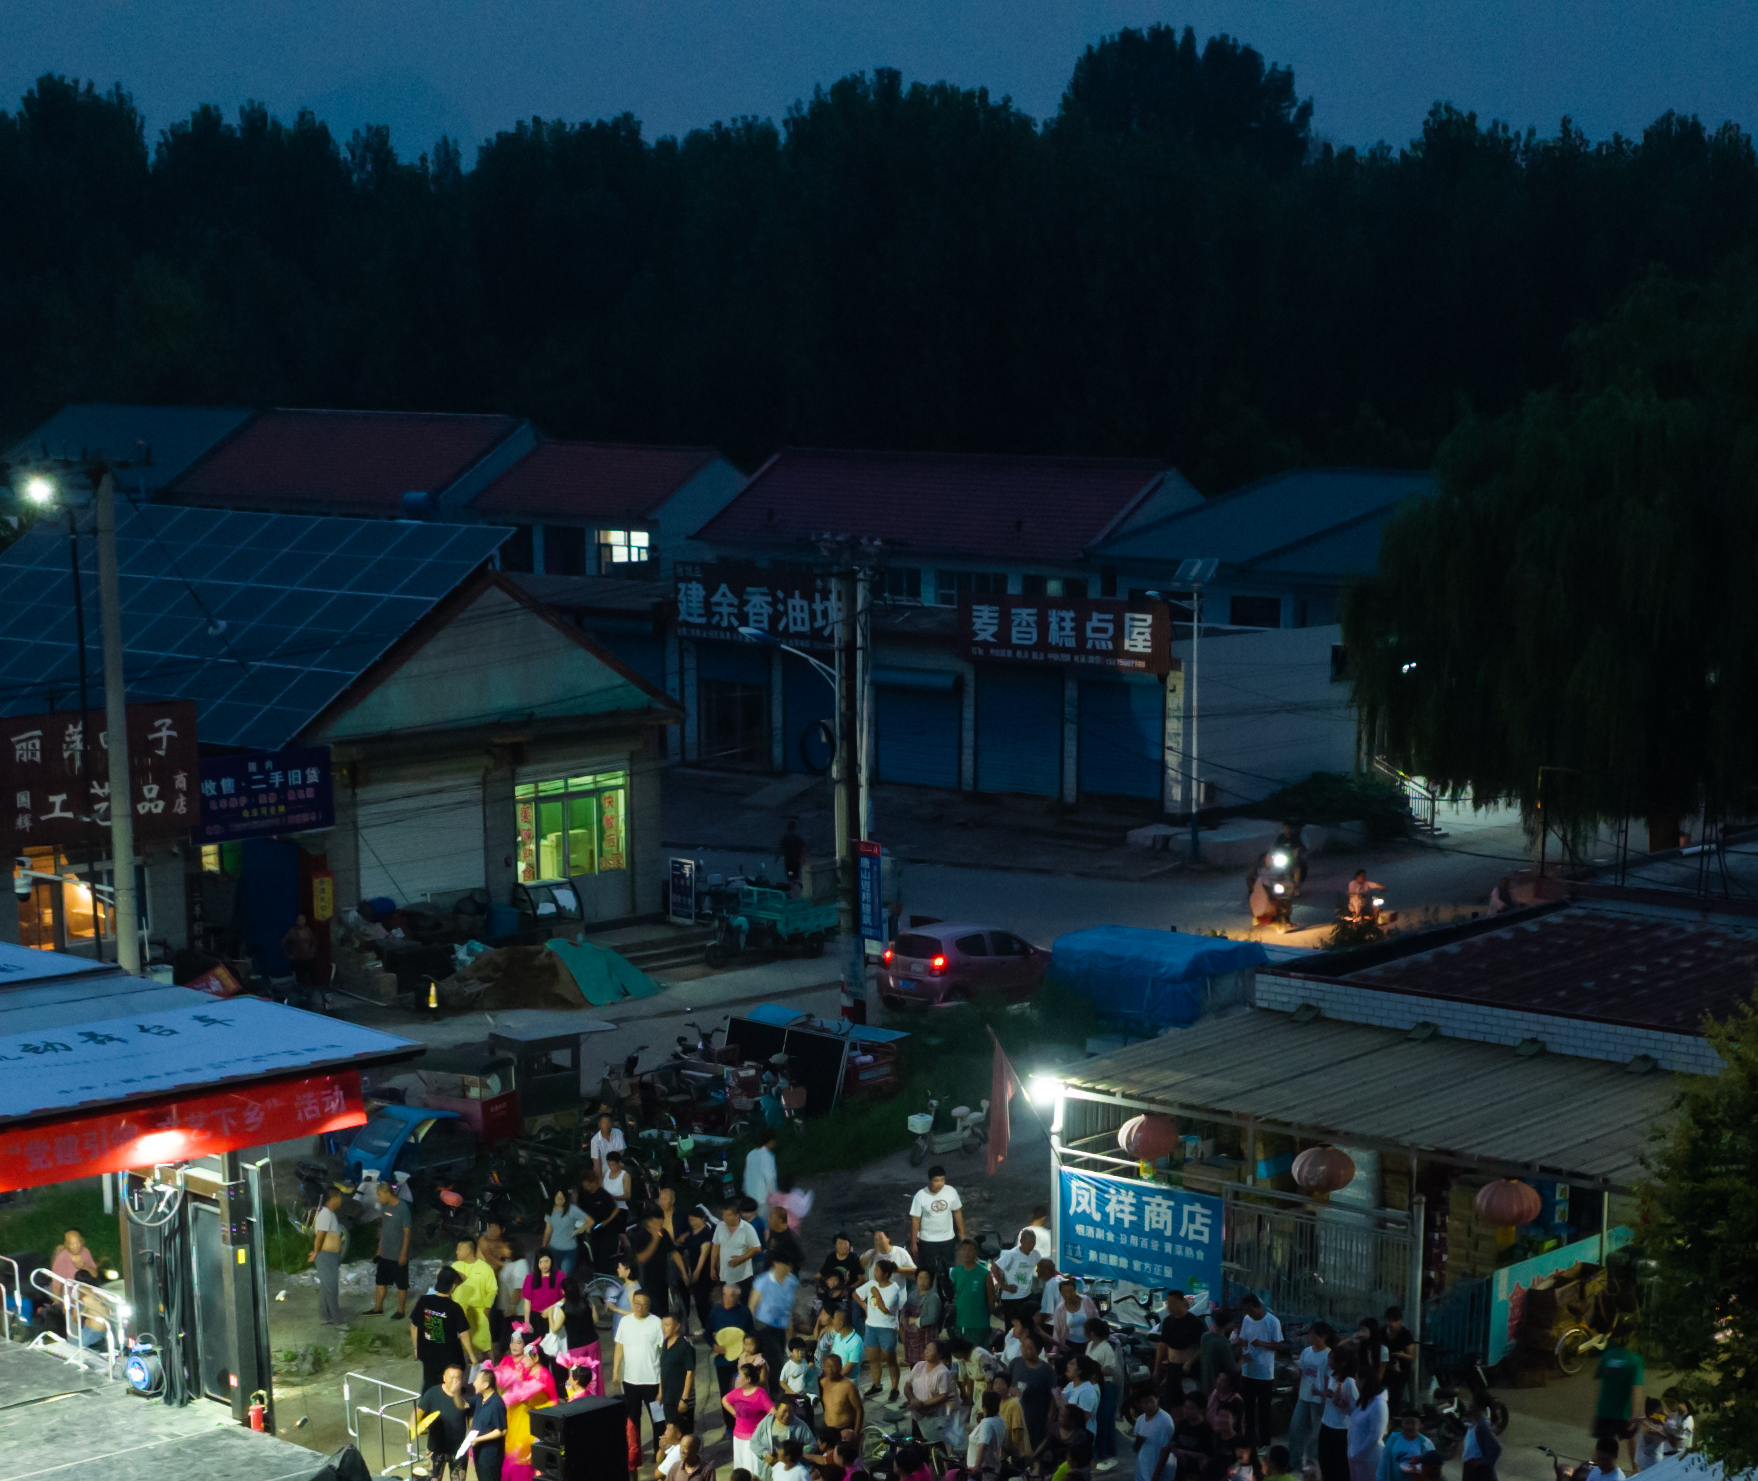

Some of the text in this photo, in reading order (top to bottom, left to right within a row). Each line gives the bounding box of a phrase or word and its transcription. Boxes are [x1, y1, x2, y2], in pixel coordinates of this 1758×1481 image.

[971, 603, 1154, 654] 麦香糕点屋
[1068, 1179, 1213, 1244] 凤祥商店
